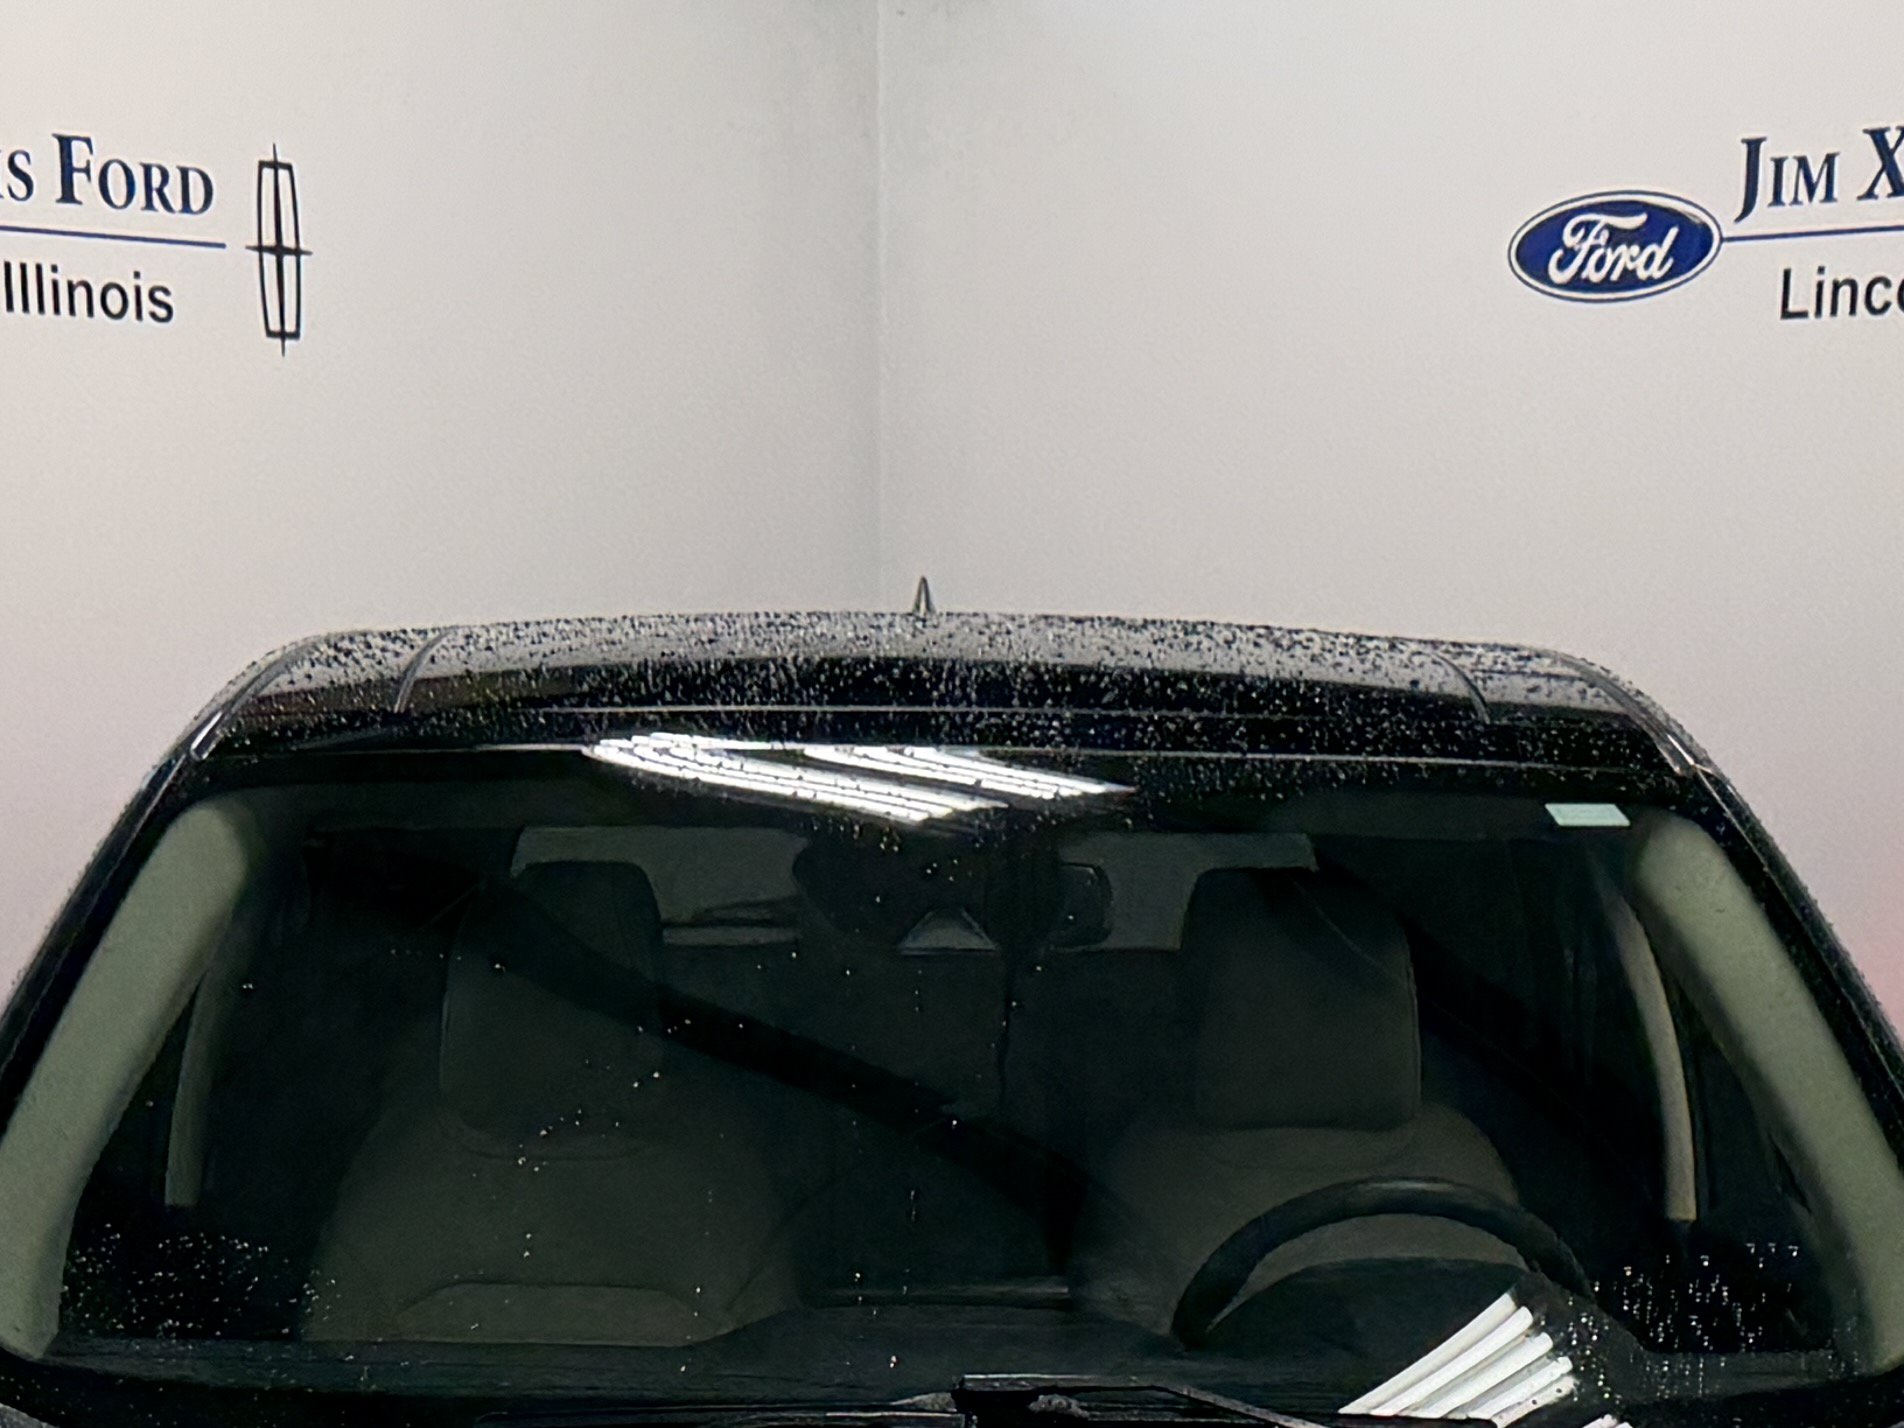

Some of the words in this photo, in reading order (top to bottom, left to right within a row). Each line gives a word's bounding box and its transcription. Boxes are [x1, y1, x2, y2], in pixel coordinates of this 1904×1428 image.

[51, 132, 214, 217] FORD
[1733, 135, 1840, 224] JIM
[1548, 212, 1674, 284] Ford
[3, 260, 175, 324] Illinois
